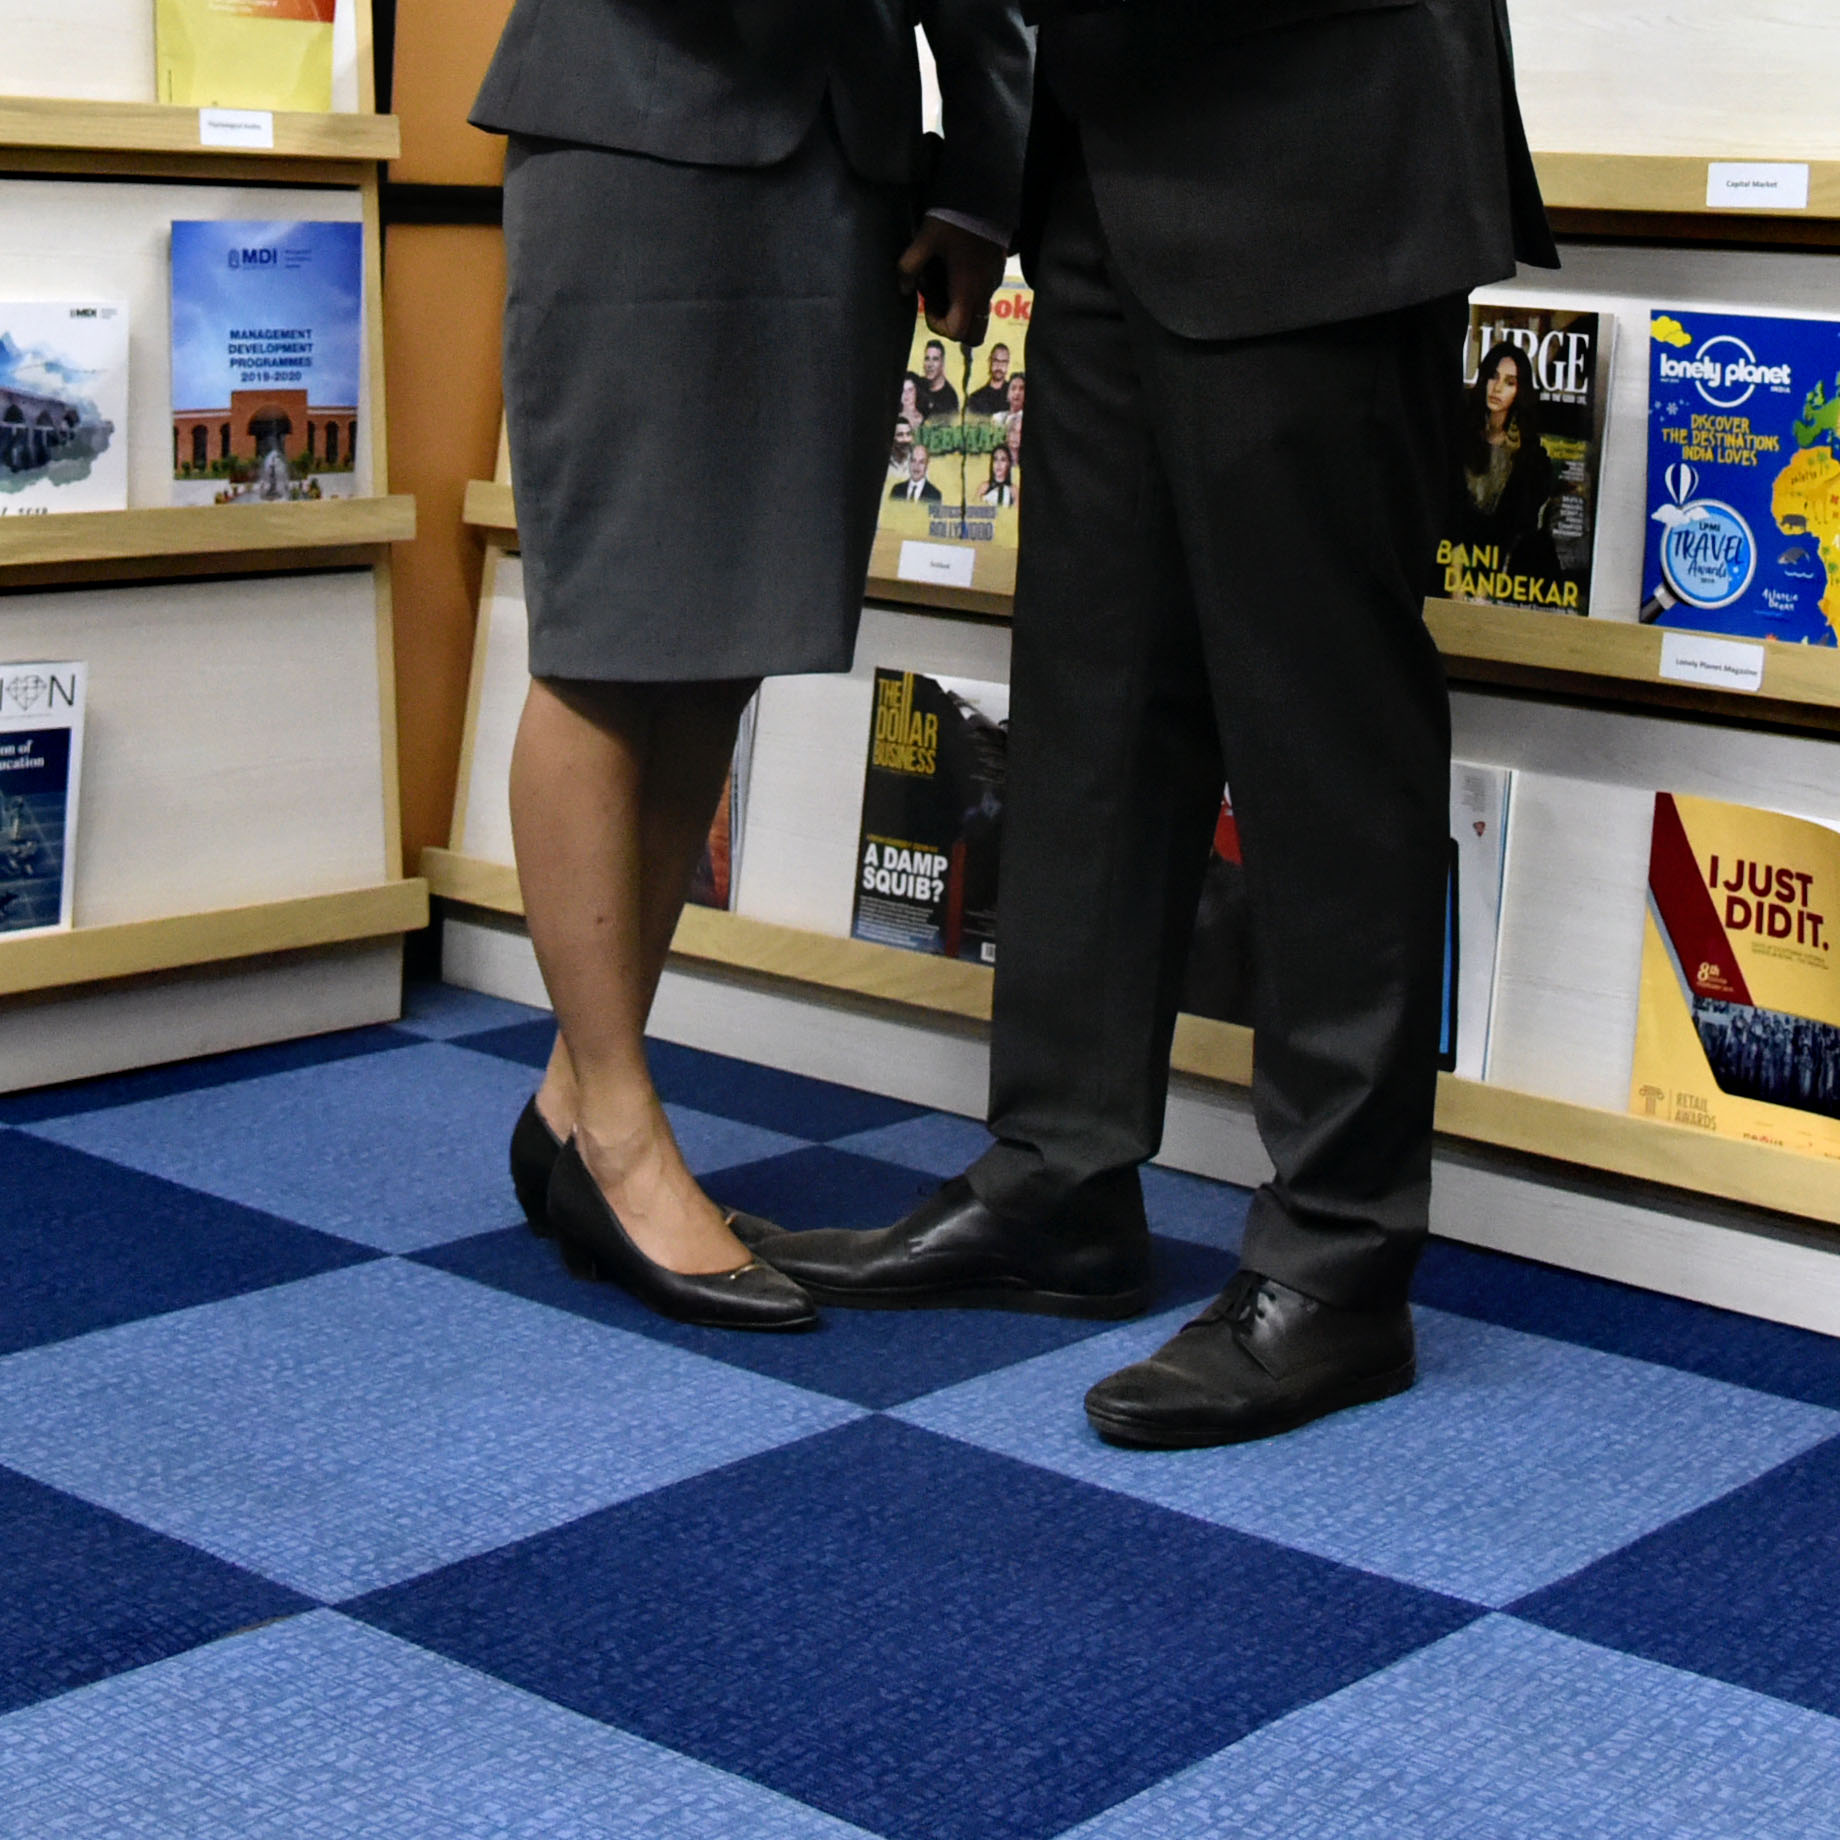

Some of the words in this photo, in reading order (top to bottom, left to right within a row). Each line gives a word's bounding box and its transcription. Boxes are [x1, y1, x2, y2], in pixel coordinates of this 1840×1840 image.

[242, 249, 277, 264] MDI
[230, 329, 312, 341] MANAGEMENT
[229, 342, 313, 355] DEVELOPMENT
[230, 357, 313, 368] PROGRAMMES
[1660, 353, 1721, 387] lonely
[1725, 358, 1791, 387] planet
[241, 371, 301, 382] 2019-2020
[1691, 413, 1750, 434] DISCOVER
[1662, 428, 1690, 444] THE
[1692, 431, 1780, 452] DESTINATIONS
[1682, 446, 1714, 461] INDIA
[1717, 448, 1758, 466] LOVES
[1674, 530, 1743, 563] TRAVEL
[878, 678, 902, 709] THE
[18, 740, 34, 753] of
[873, 739, 936, 775] BUSINESS
[865, 842, 878, 864] A
[883, 846, 948, 879] DAMP
[862, 867, 944, 903] SQUIB?
[1709, 854, 1719, 888] I
[1723, 857, 1814, 907] JUST
[1724, 895, 1793, 939] DID
[1676, 1092, 1709, 1111] RETAIL
[1675, 1109, 1717, 1131] AWARDS
